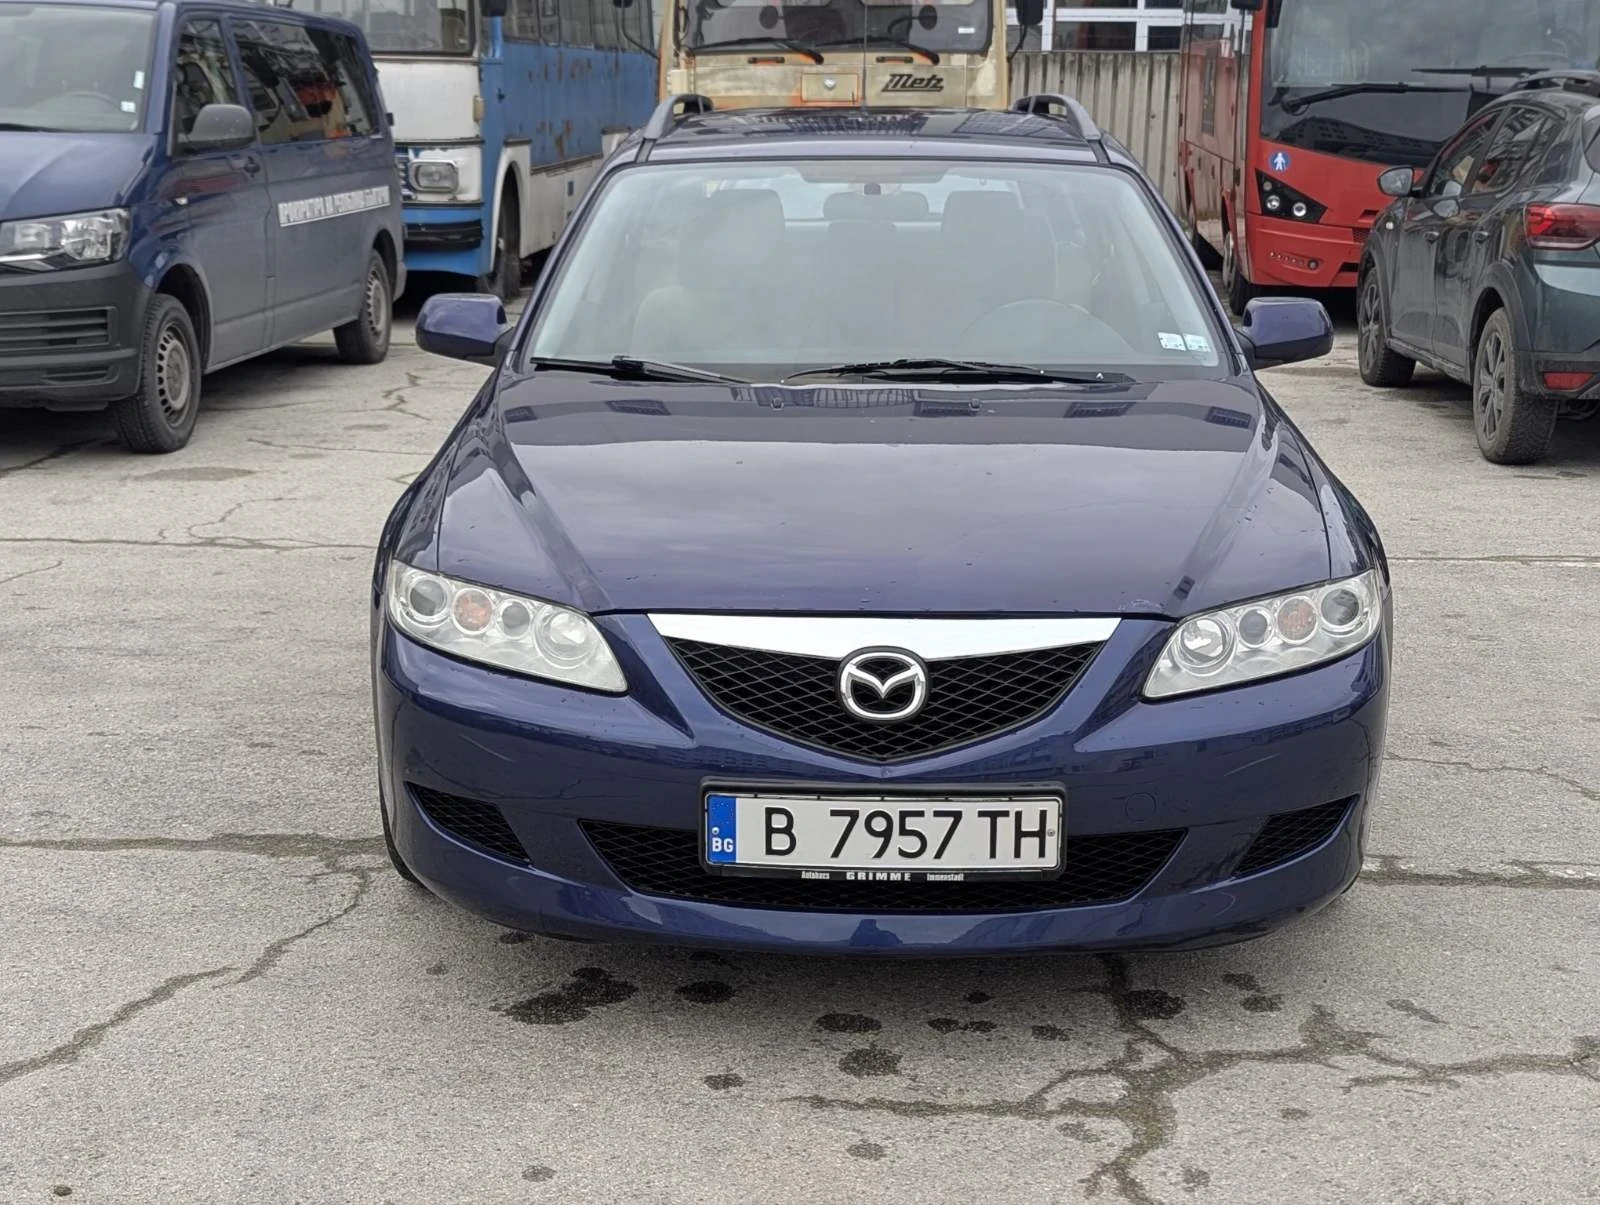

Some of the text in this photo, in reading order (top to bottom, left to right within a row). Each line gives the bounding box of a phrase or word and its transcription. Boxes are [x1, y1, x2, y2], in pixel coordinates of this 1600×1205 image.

[881, 73, 944, 92] Metz
[764, 807, 1048, 859] B 7957 TH
[712, 837, 734, 852] BG
[846, 871, 912, 881] GRIMME
